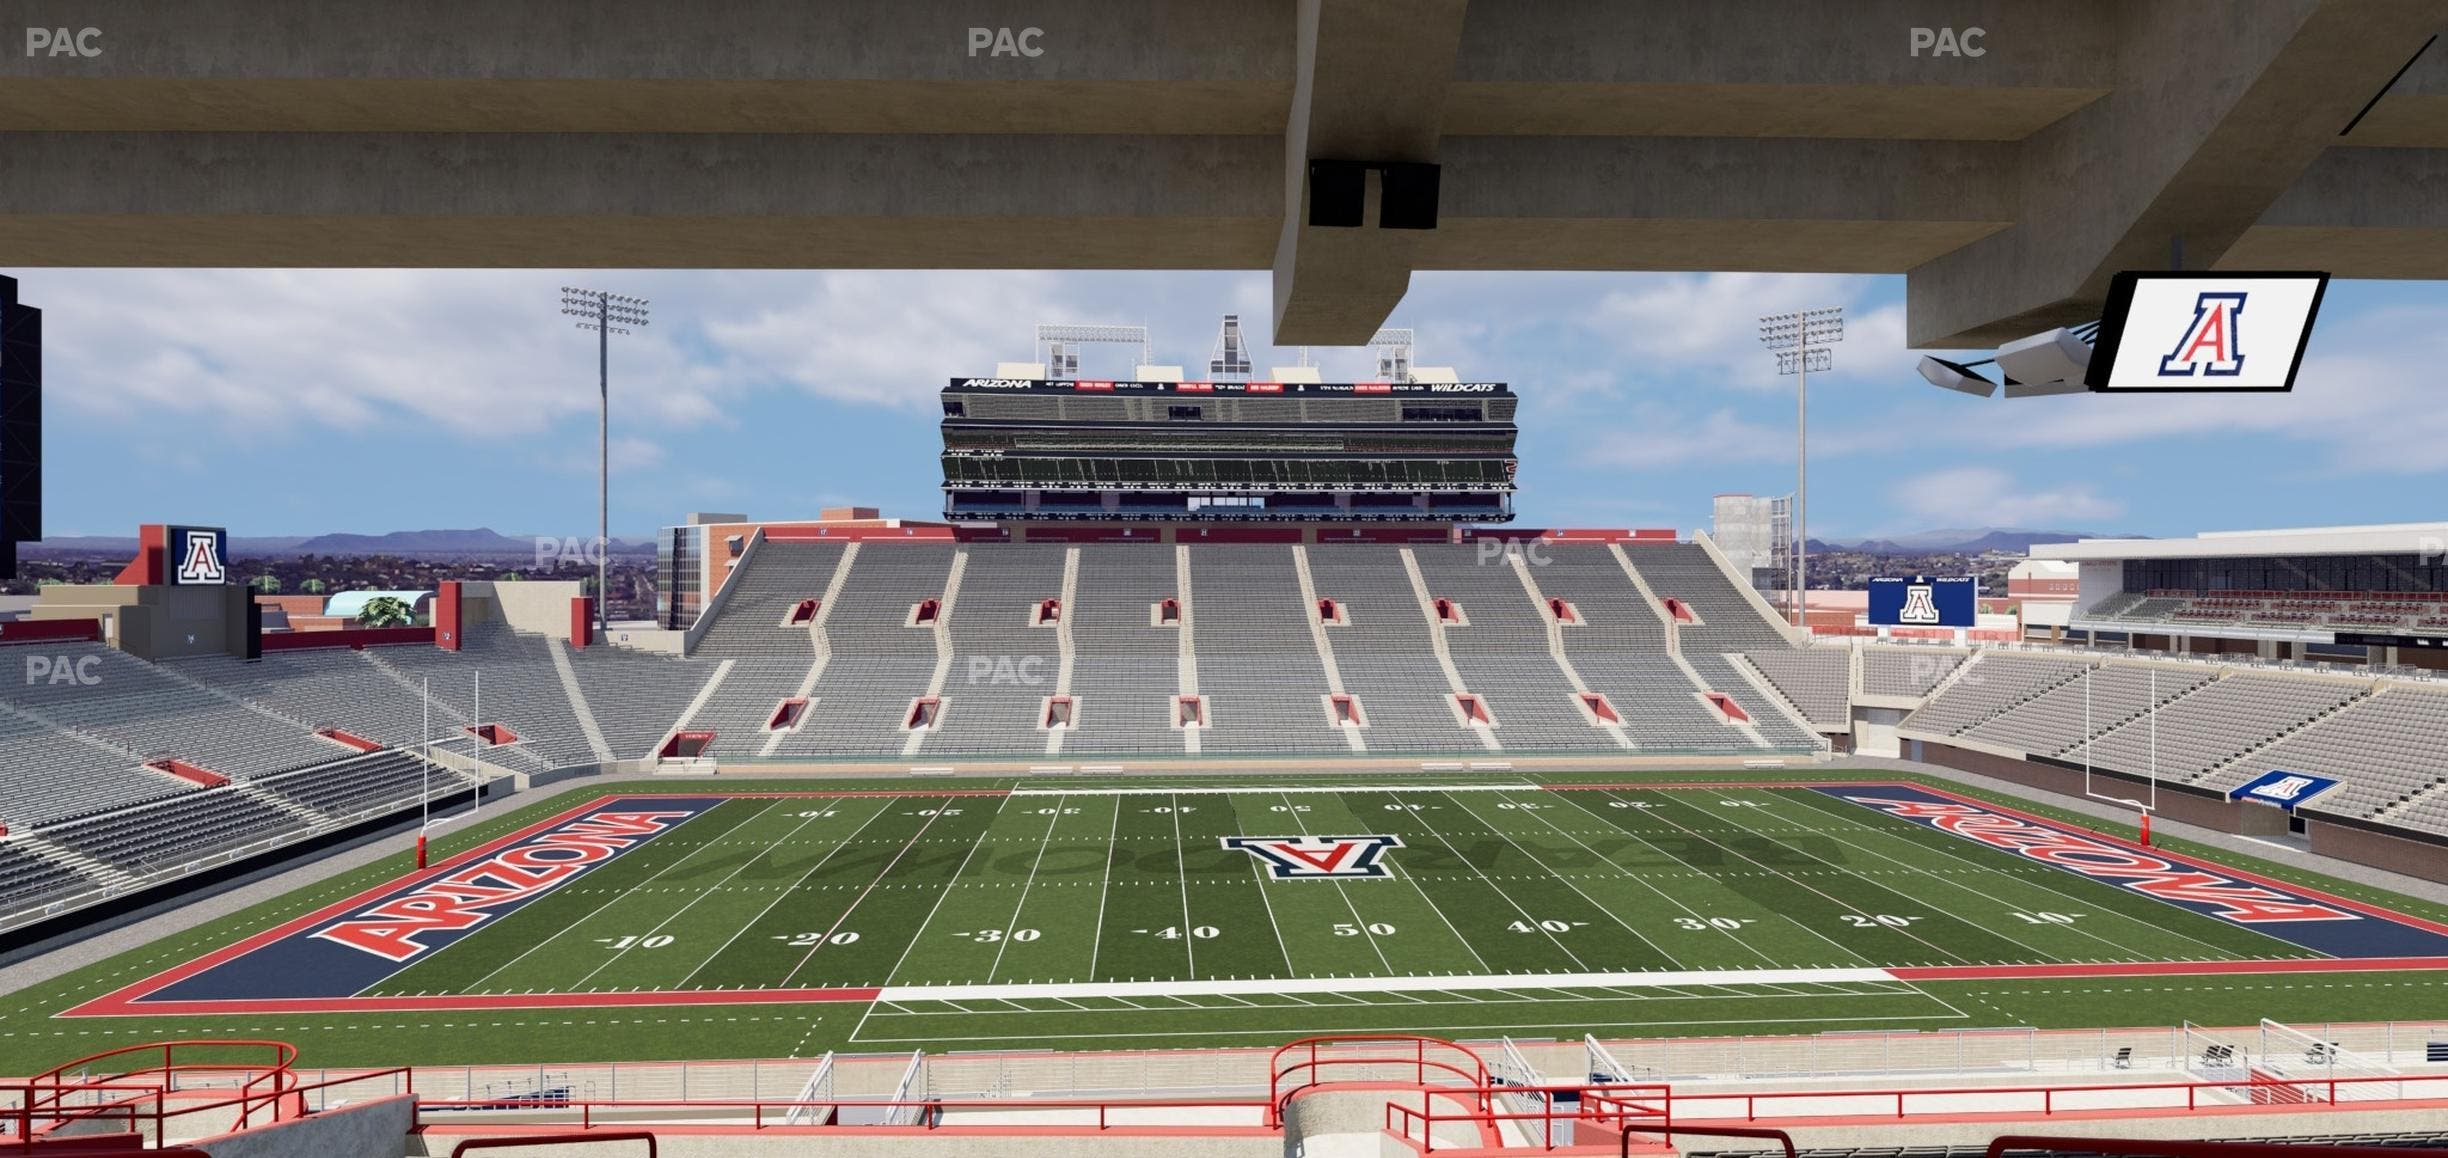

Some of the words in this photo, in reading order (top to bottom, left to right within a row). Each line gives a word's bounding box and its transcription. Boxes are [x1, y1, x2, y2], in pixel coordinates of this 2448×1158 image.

[2157, 292, 2249, 377] A
[962, 379, 1032, 388] ARIZONA
[1431, 383, 1496, 392] WILDCATS
[178, 531, 225, 584] A
[1900, 585, 1939, 623] A
[2249, 775, 2315, 801] A
[1219, 834, 1407, 881] A
[1842, 795, 2364, 923] ARIZONA
[306, 810, 694, 963] ARIZONA
[1673, 917, 1741, 930] 30
[1840, 914, 1910, 927] 20
[2006, 911, 2075, 925] 10
[1153, 926, 1221, 940] 40
[1333, 923, 1396, 937] 50
[1507, 920, 1570, 933] 40
[604, 934, 675, 949] 10
[787, 932, 860, 946] 20
[973, 928, 1041, 943] 30
